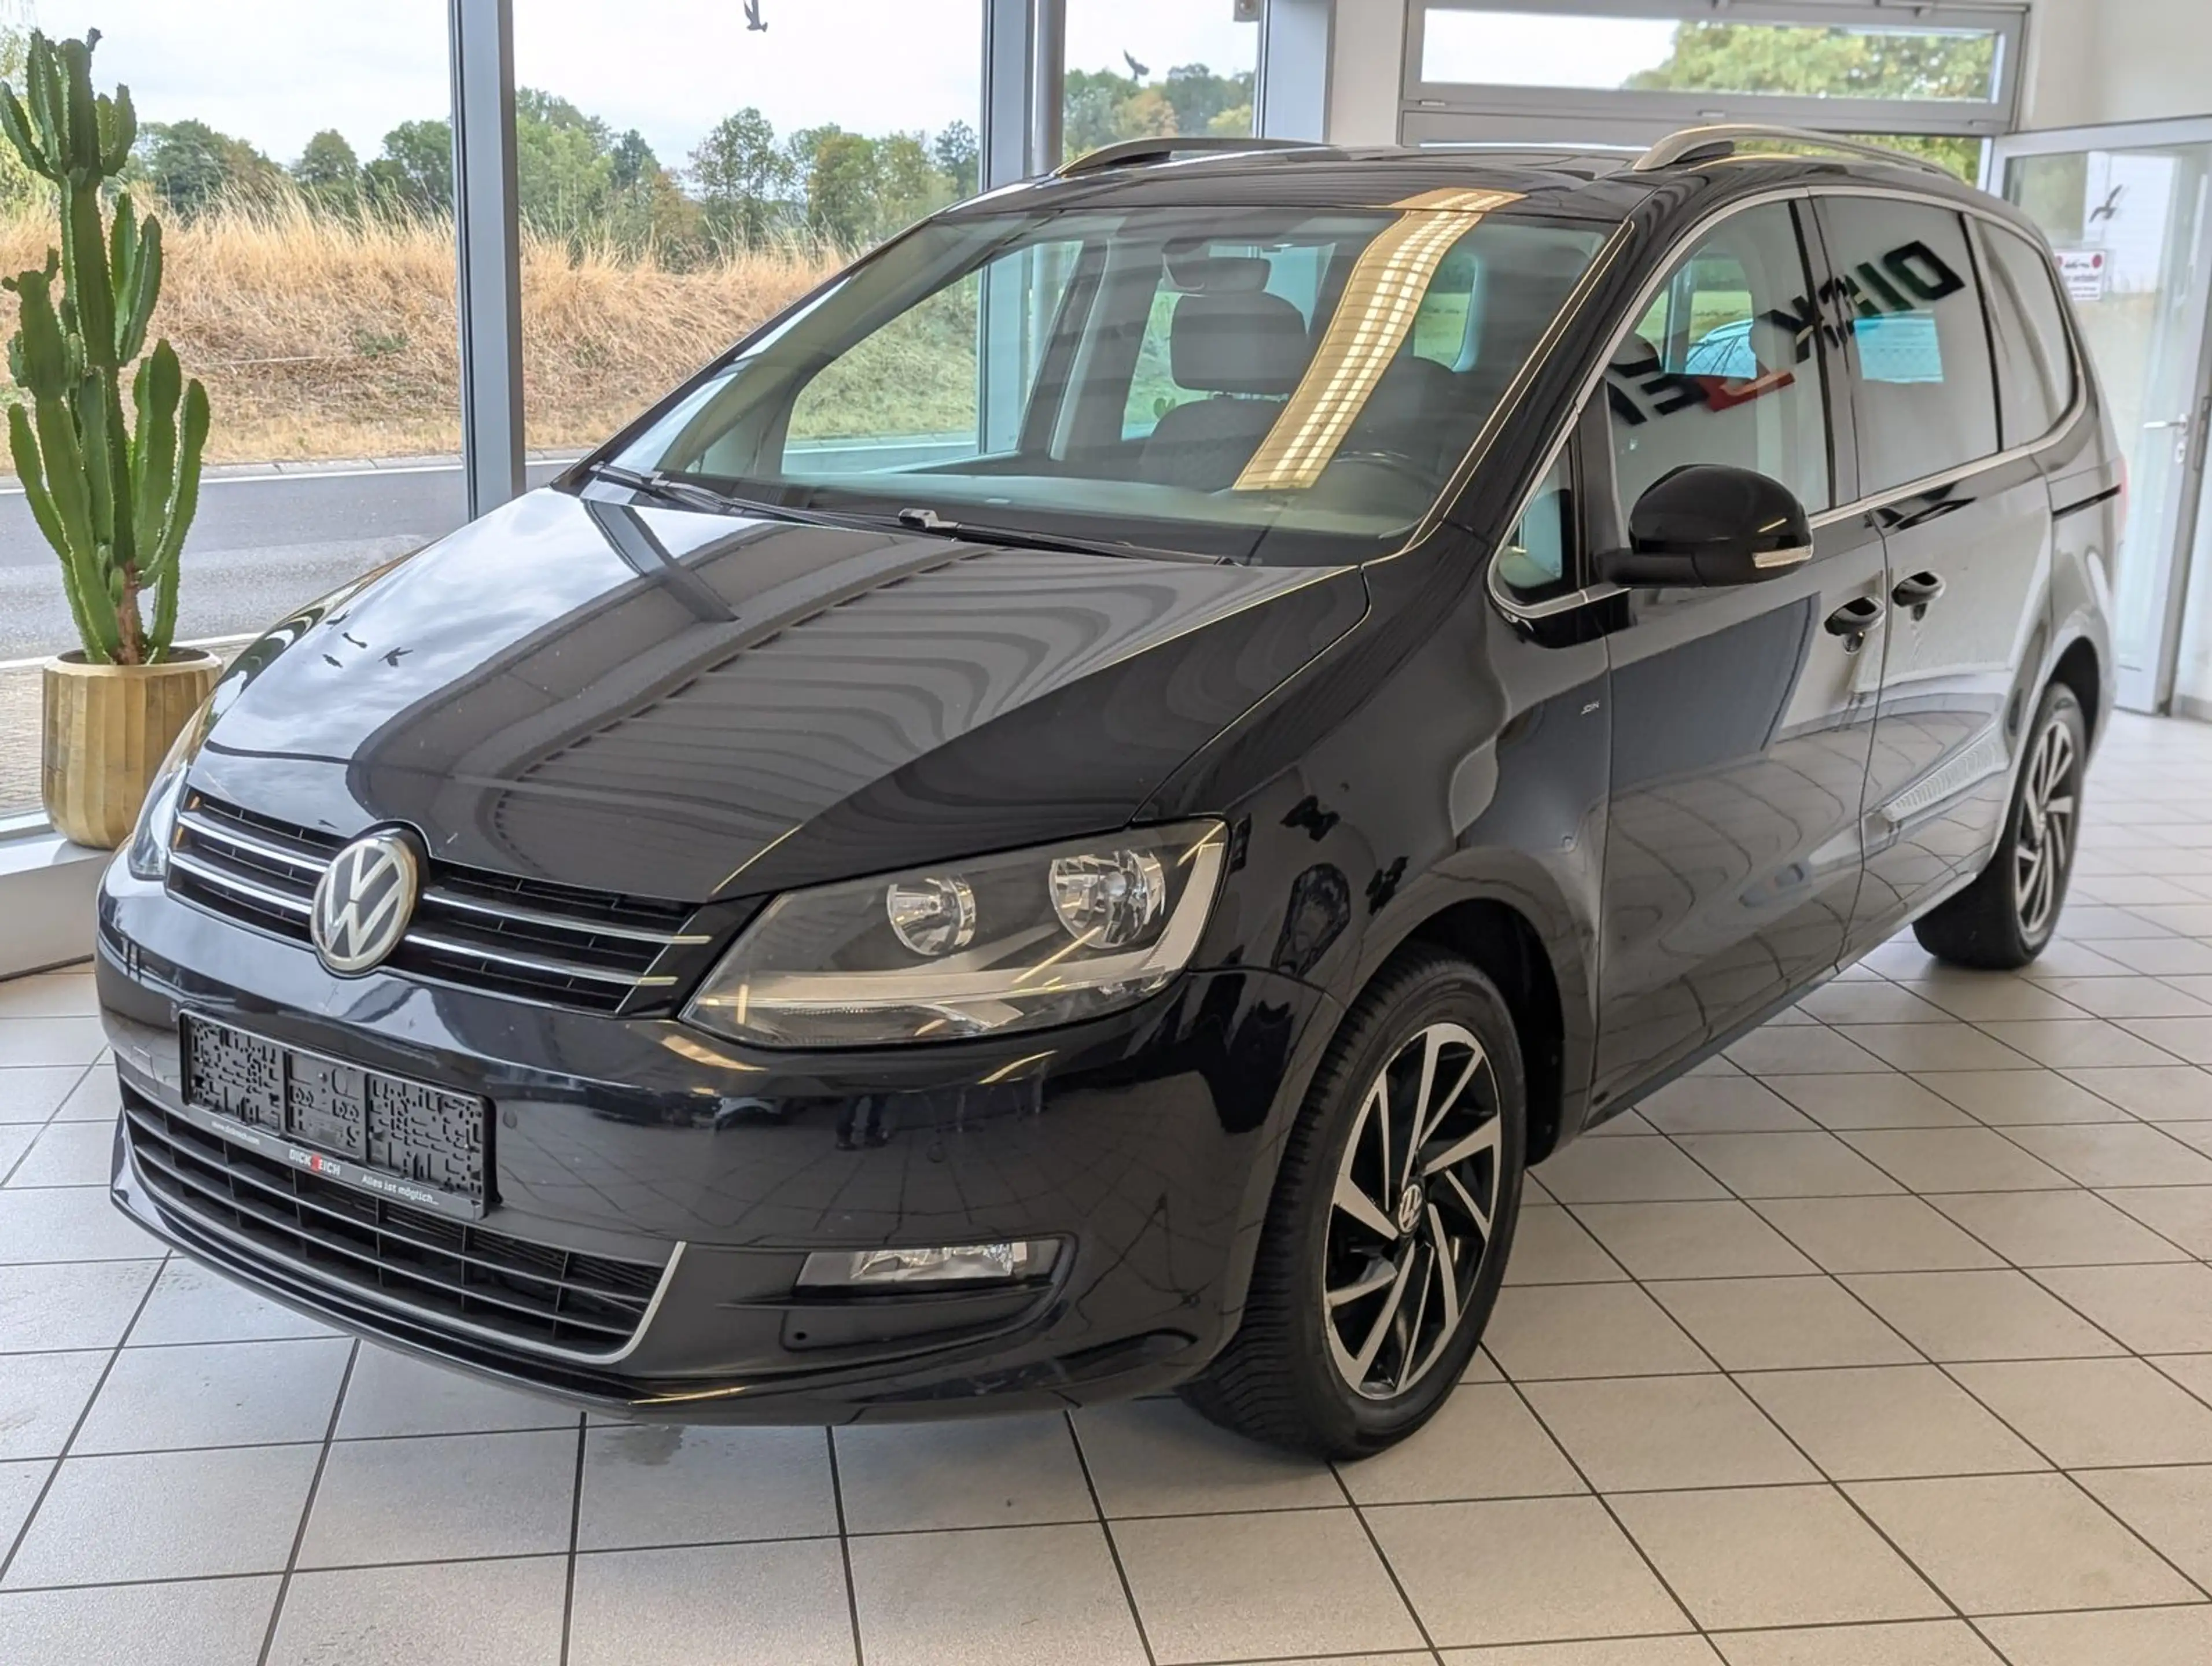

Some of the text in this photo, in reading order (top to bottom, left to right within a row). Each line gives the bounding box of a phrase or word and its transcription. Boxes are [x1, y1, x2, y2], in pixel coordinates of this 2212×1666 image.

[318, 841, 409, 967] VW
[361, 1173, 382, 1189] Alles
[384, 1180, 397, 1193] ist
